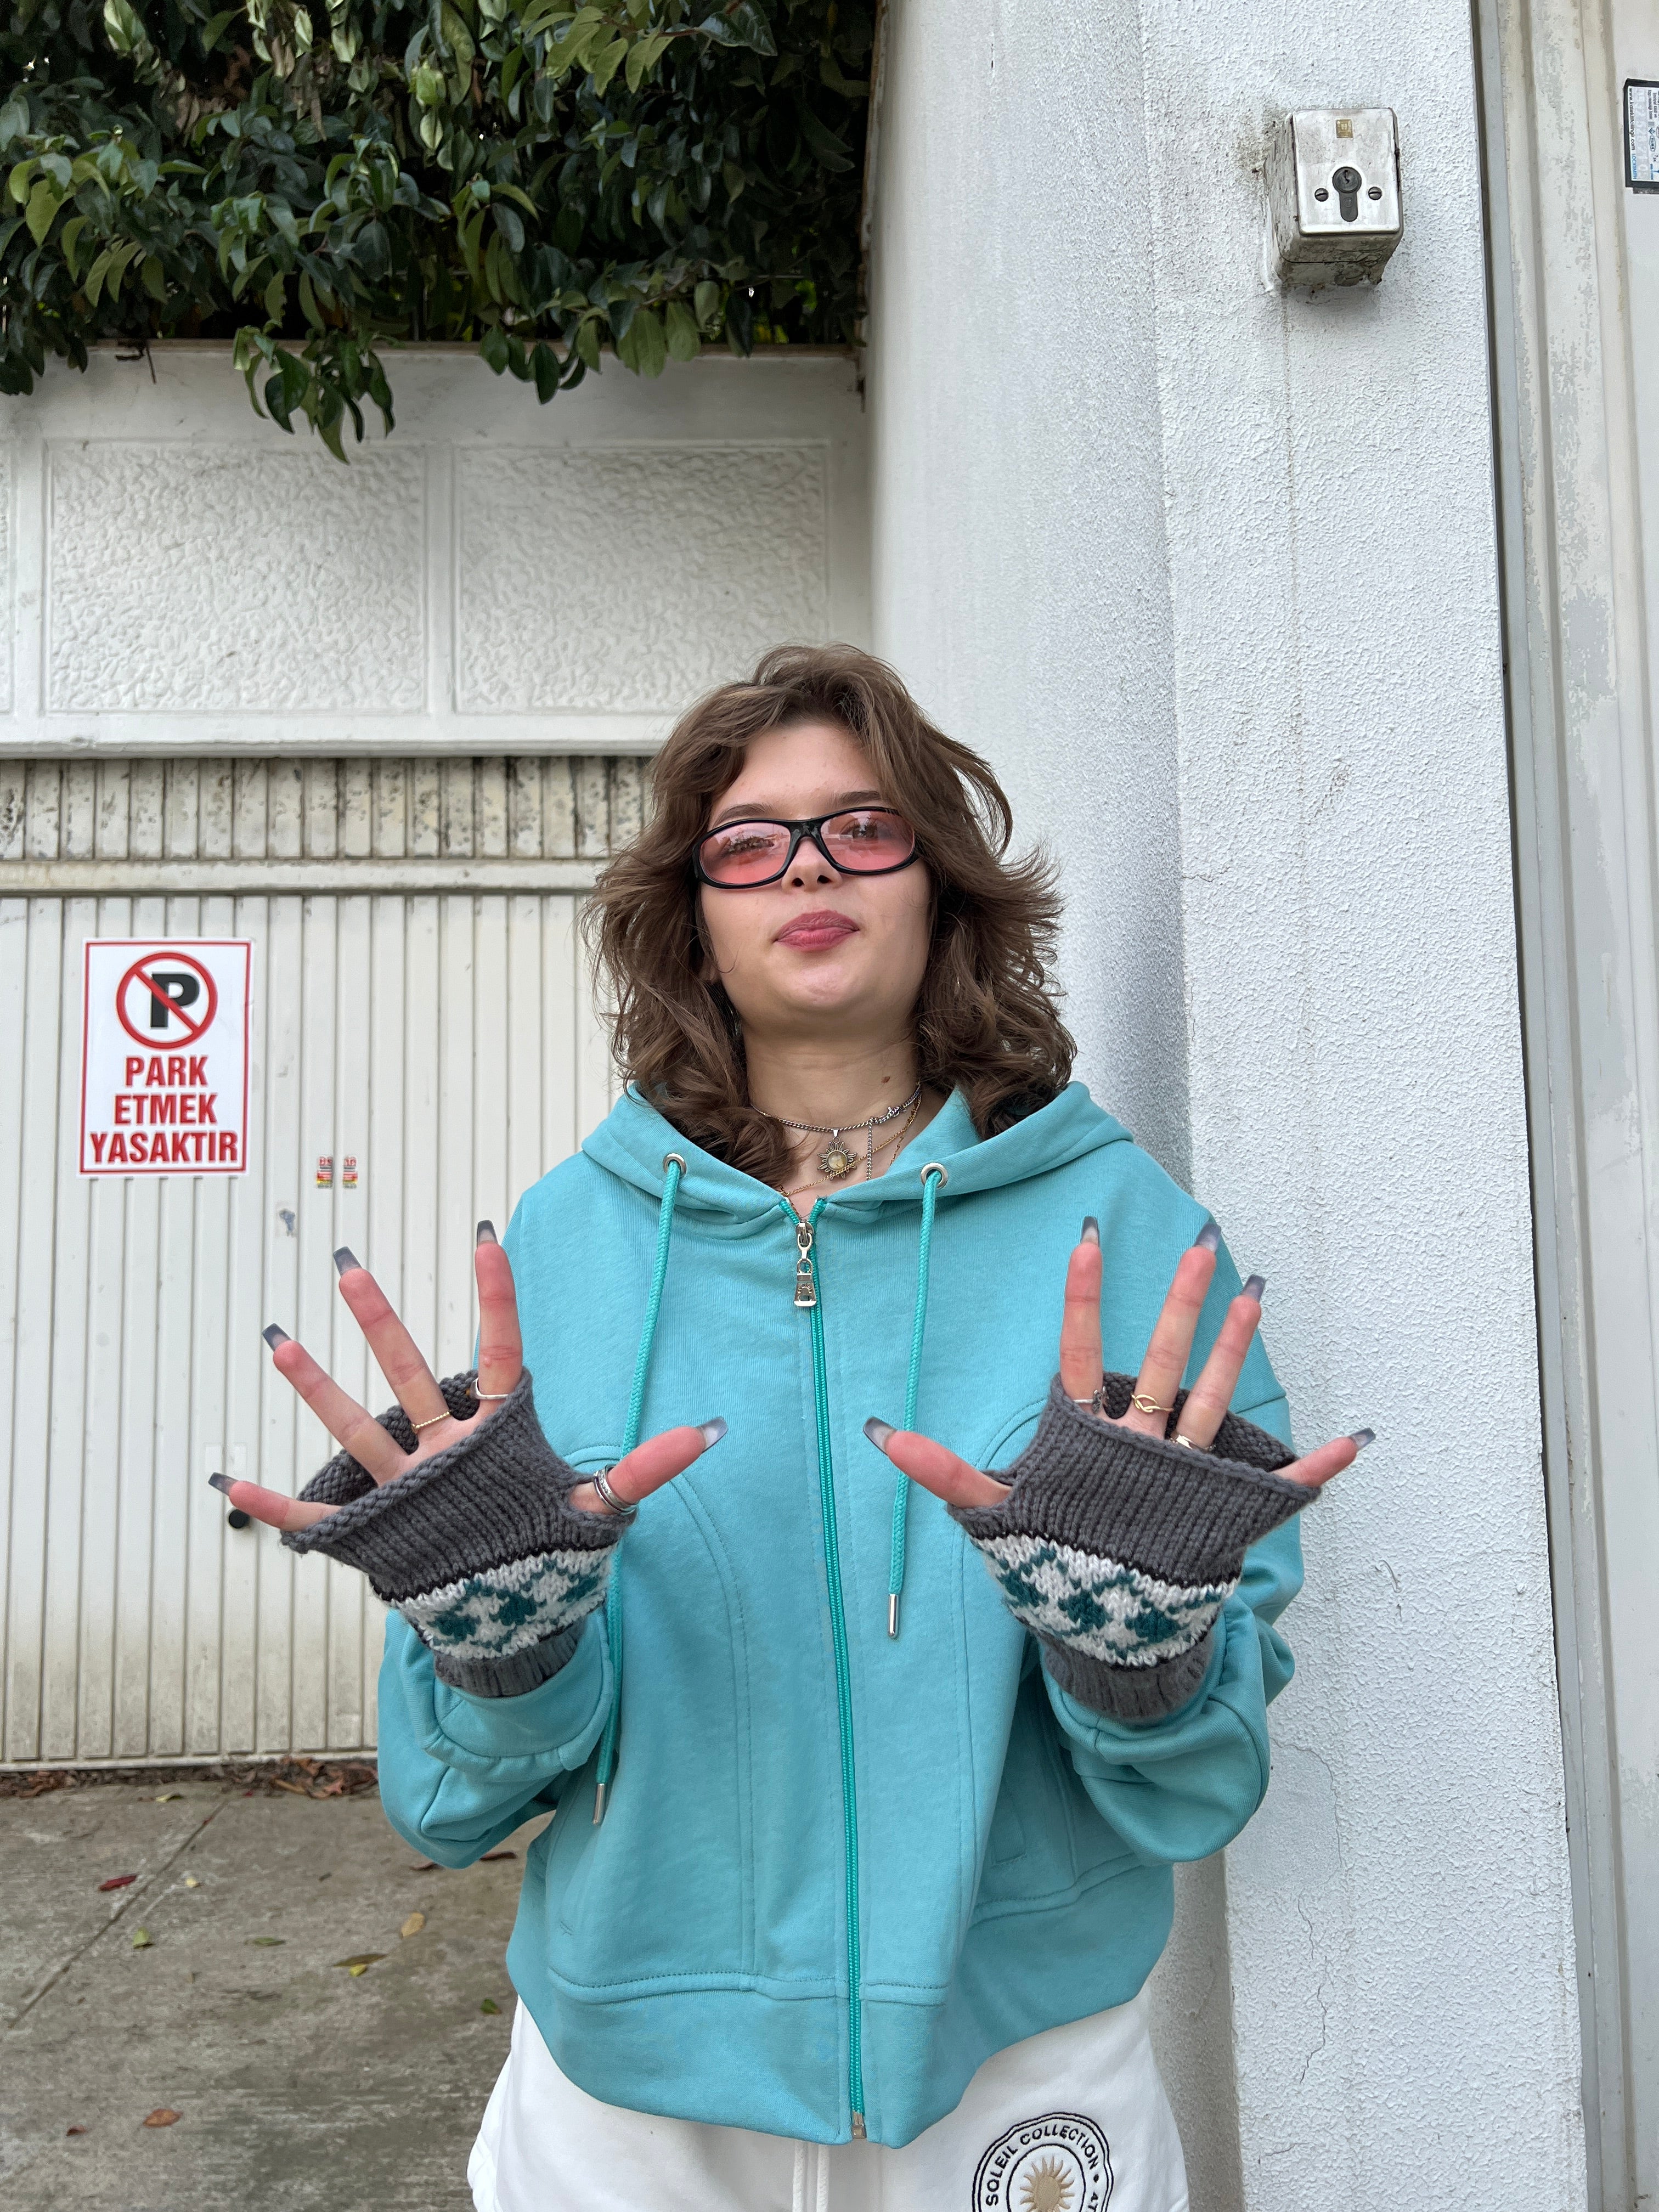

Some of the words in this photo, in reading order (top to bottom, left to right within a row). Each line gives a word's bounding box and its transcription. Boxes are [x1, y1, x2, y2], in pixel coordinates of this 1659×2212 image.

[150, 972, 200, 1029] P
[125, 1056, 208, 1087] PARK
[114, 1093, 218, 1126] ETMEK
[89, 1131, 238, 1164] YASAKTIR
[985, 2145, 1018, 2206] SOLEIL
[1019, 2124, 1099, 2170] COLLECTION
